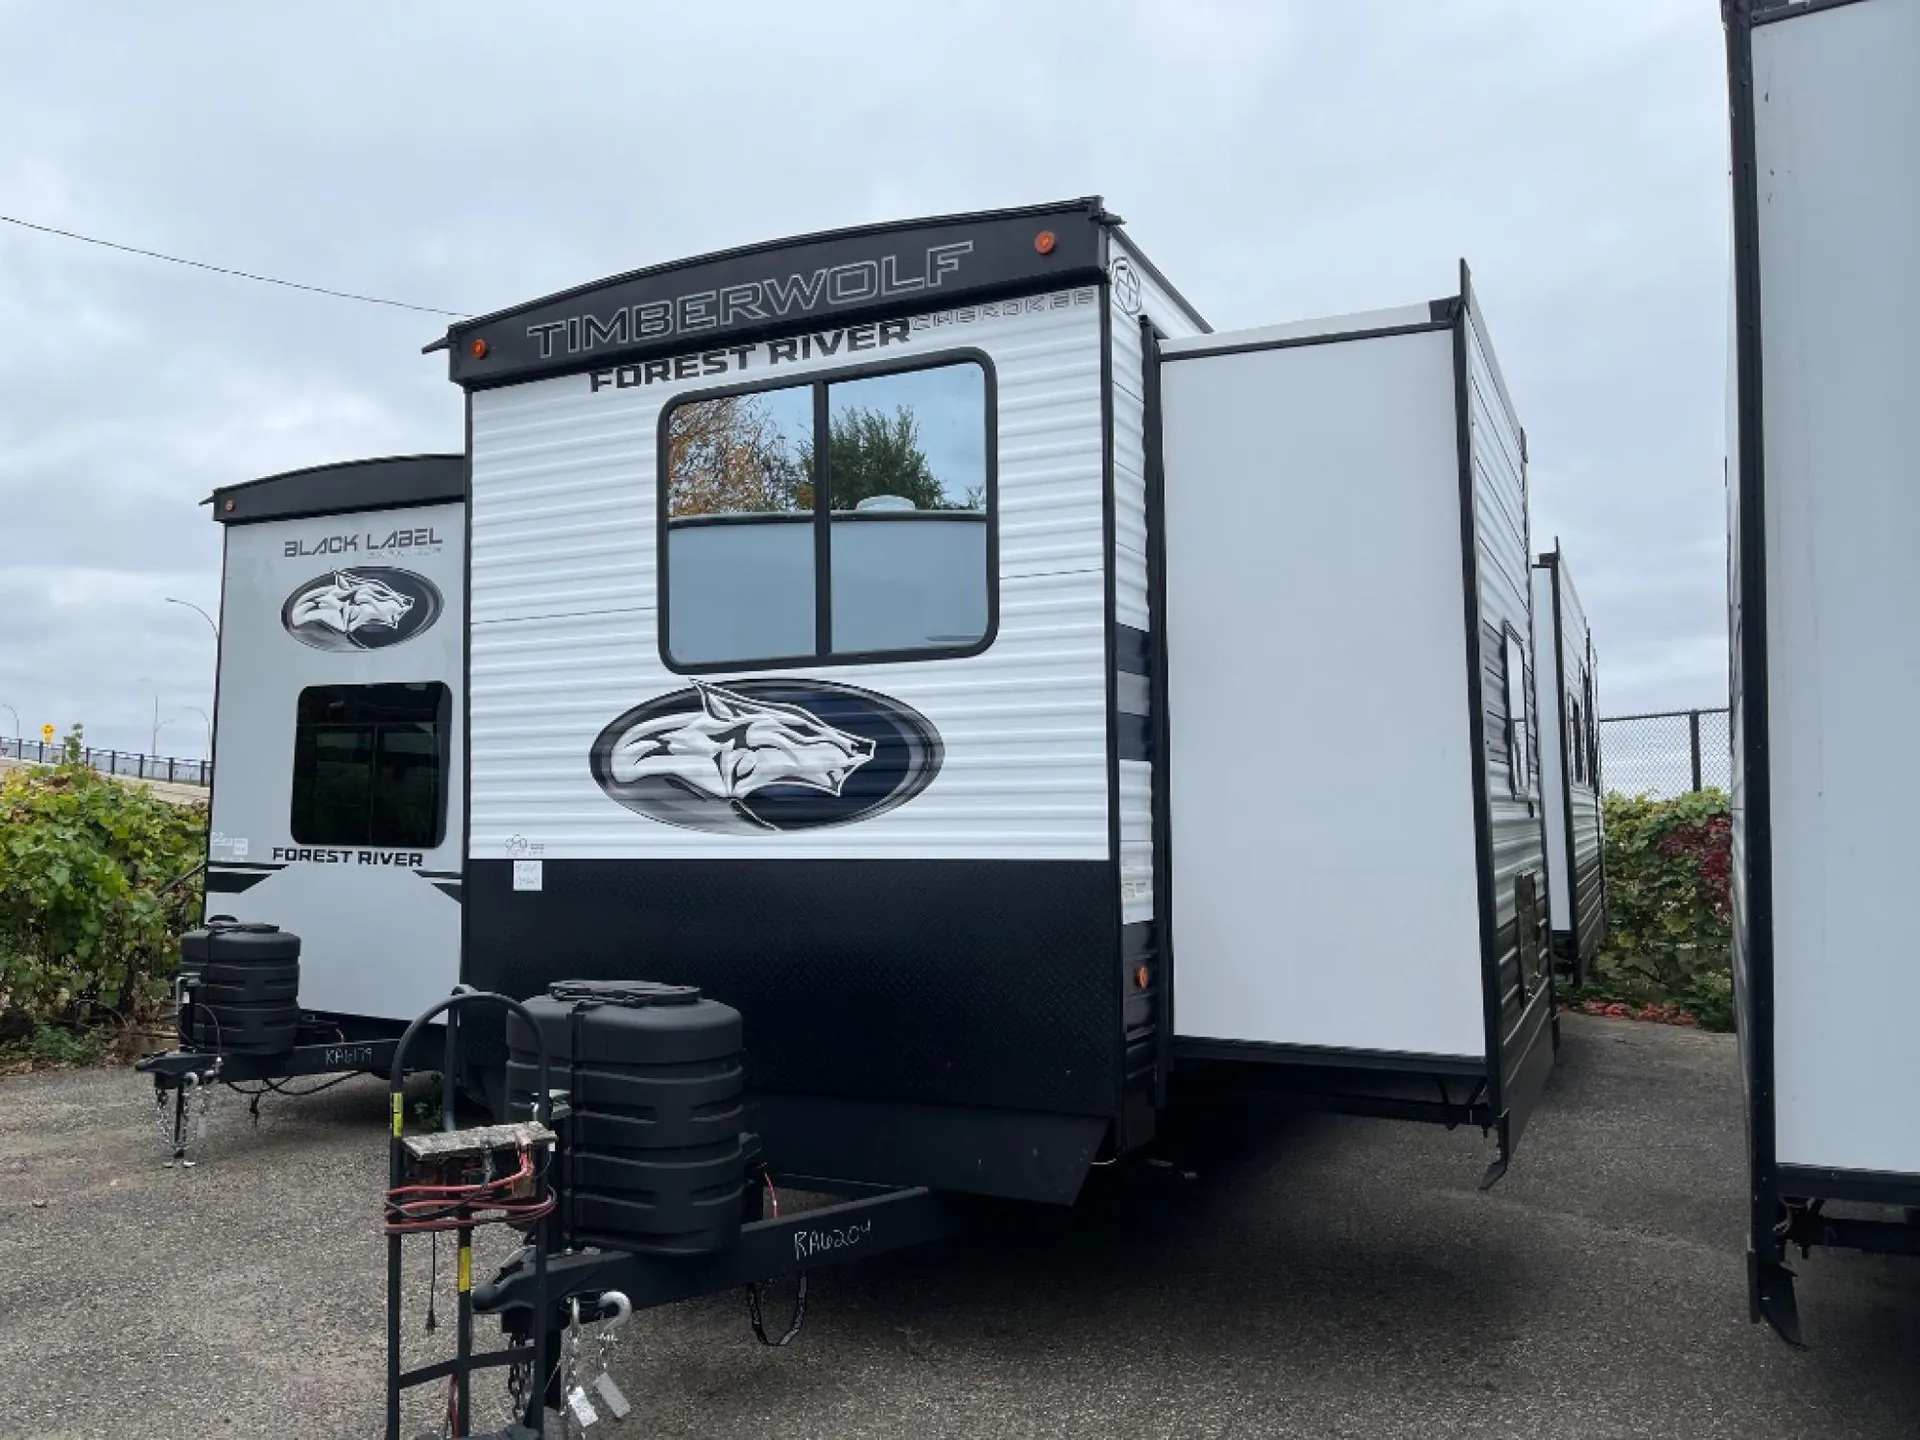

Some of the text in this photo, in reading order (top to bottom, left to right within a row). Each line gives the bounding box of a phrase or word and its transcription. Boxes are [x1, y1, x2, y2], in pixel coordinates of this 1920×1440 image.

[527, 240, 975, 359] TIMBERWOLF
[909, 287, 1095, 331] CHEROKEE
[589, 317, 911, 393] FOREST RIVER
[284, 534, 359, 558] BLACK
[366, 527, 444, 550] LABEL
[272, 847, 424, 867] FOREST RIVER
